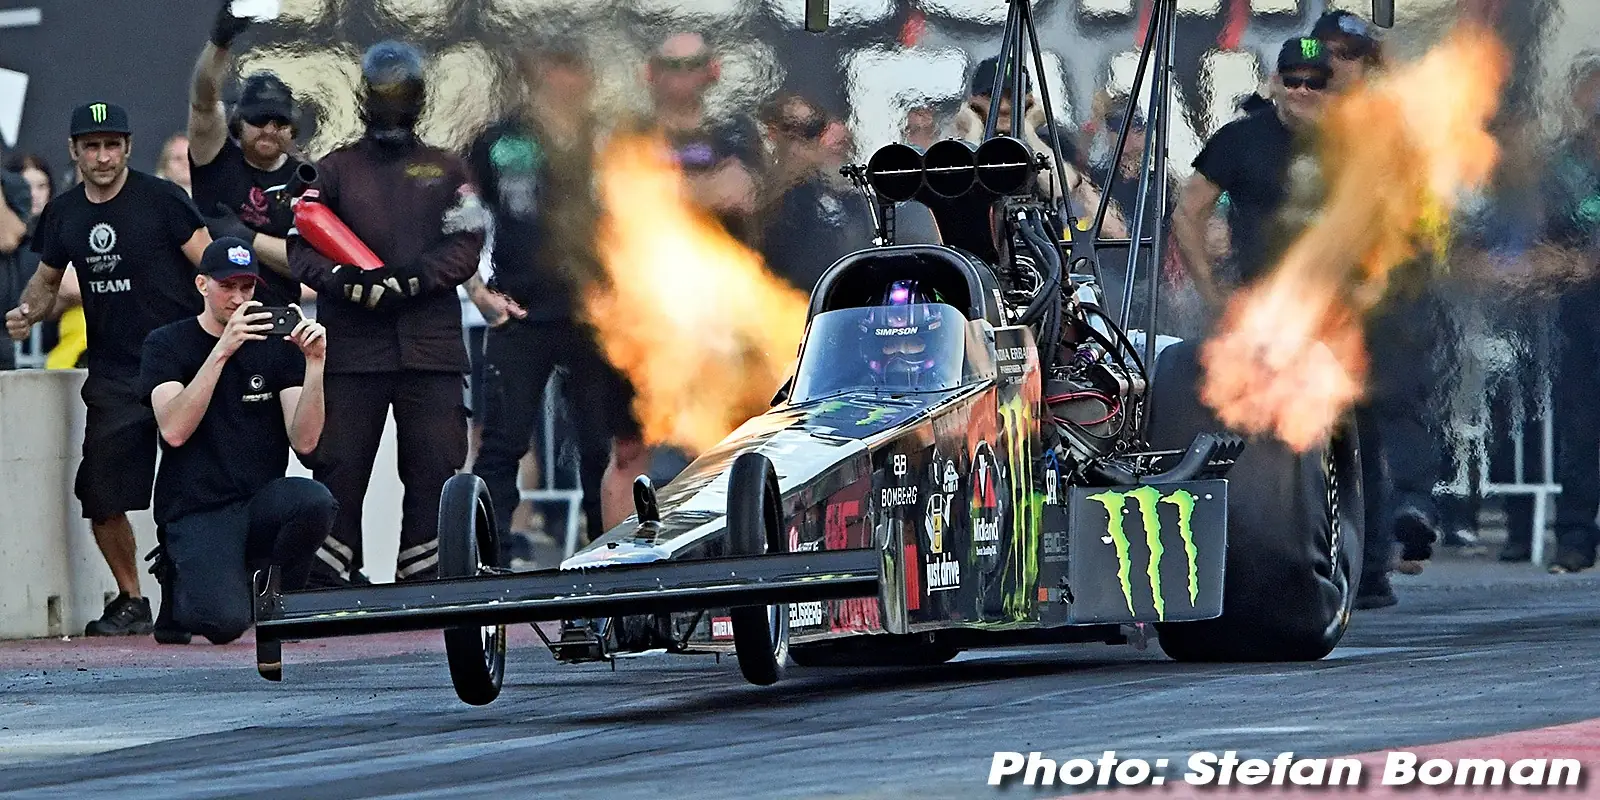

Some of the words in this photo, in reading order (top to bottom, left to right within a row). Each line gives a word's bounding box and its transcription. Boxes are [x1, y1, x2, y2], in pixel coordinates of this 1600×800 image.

[88, 279, 131, 293] TEAM
[875, 326, 919, 336] SIMPSON
[881, 485, 918, 508] BOMBERG
[973, 516, 999, 542] Midland
[926, 553, 941, 597] just
[940, 551, 960, 587] drive
